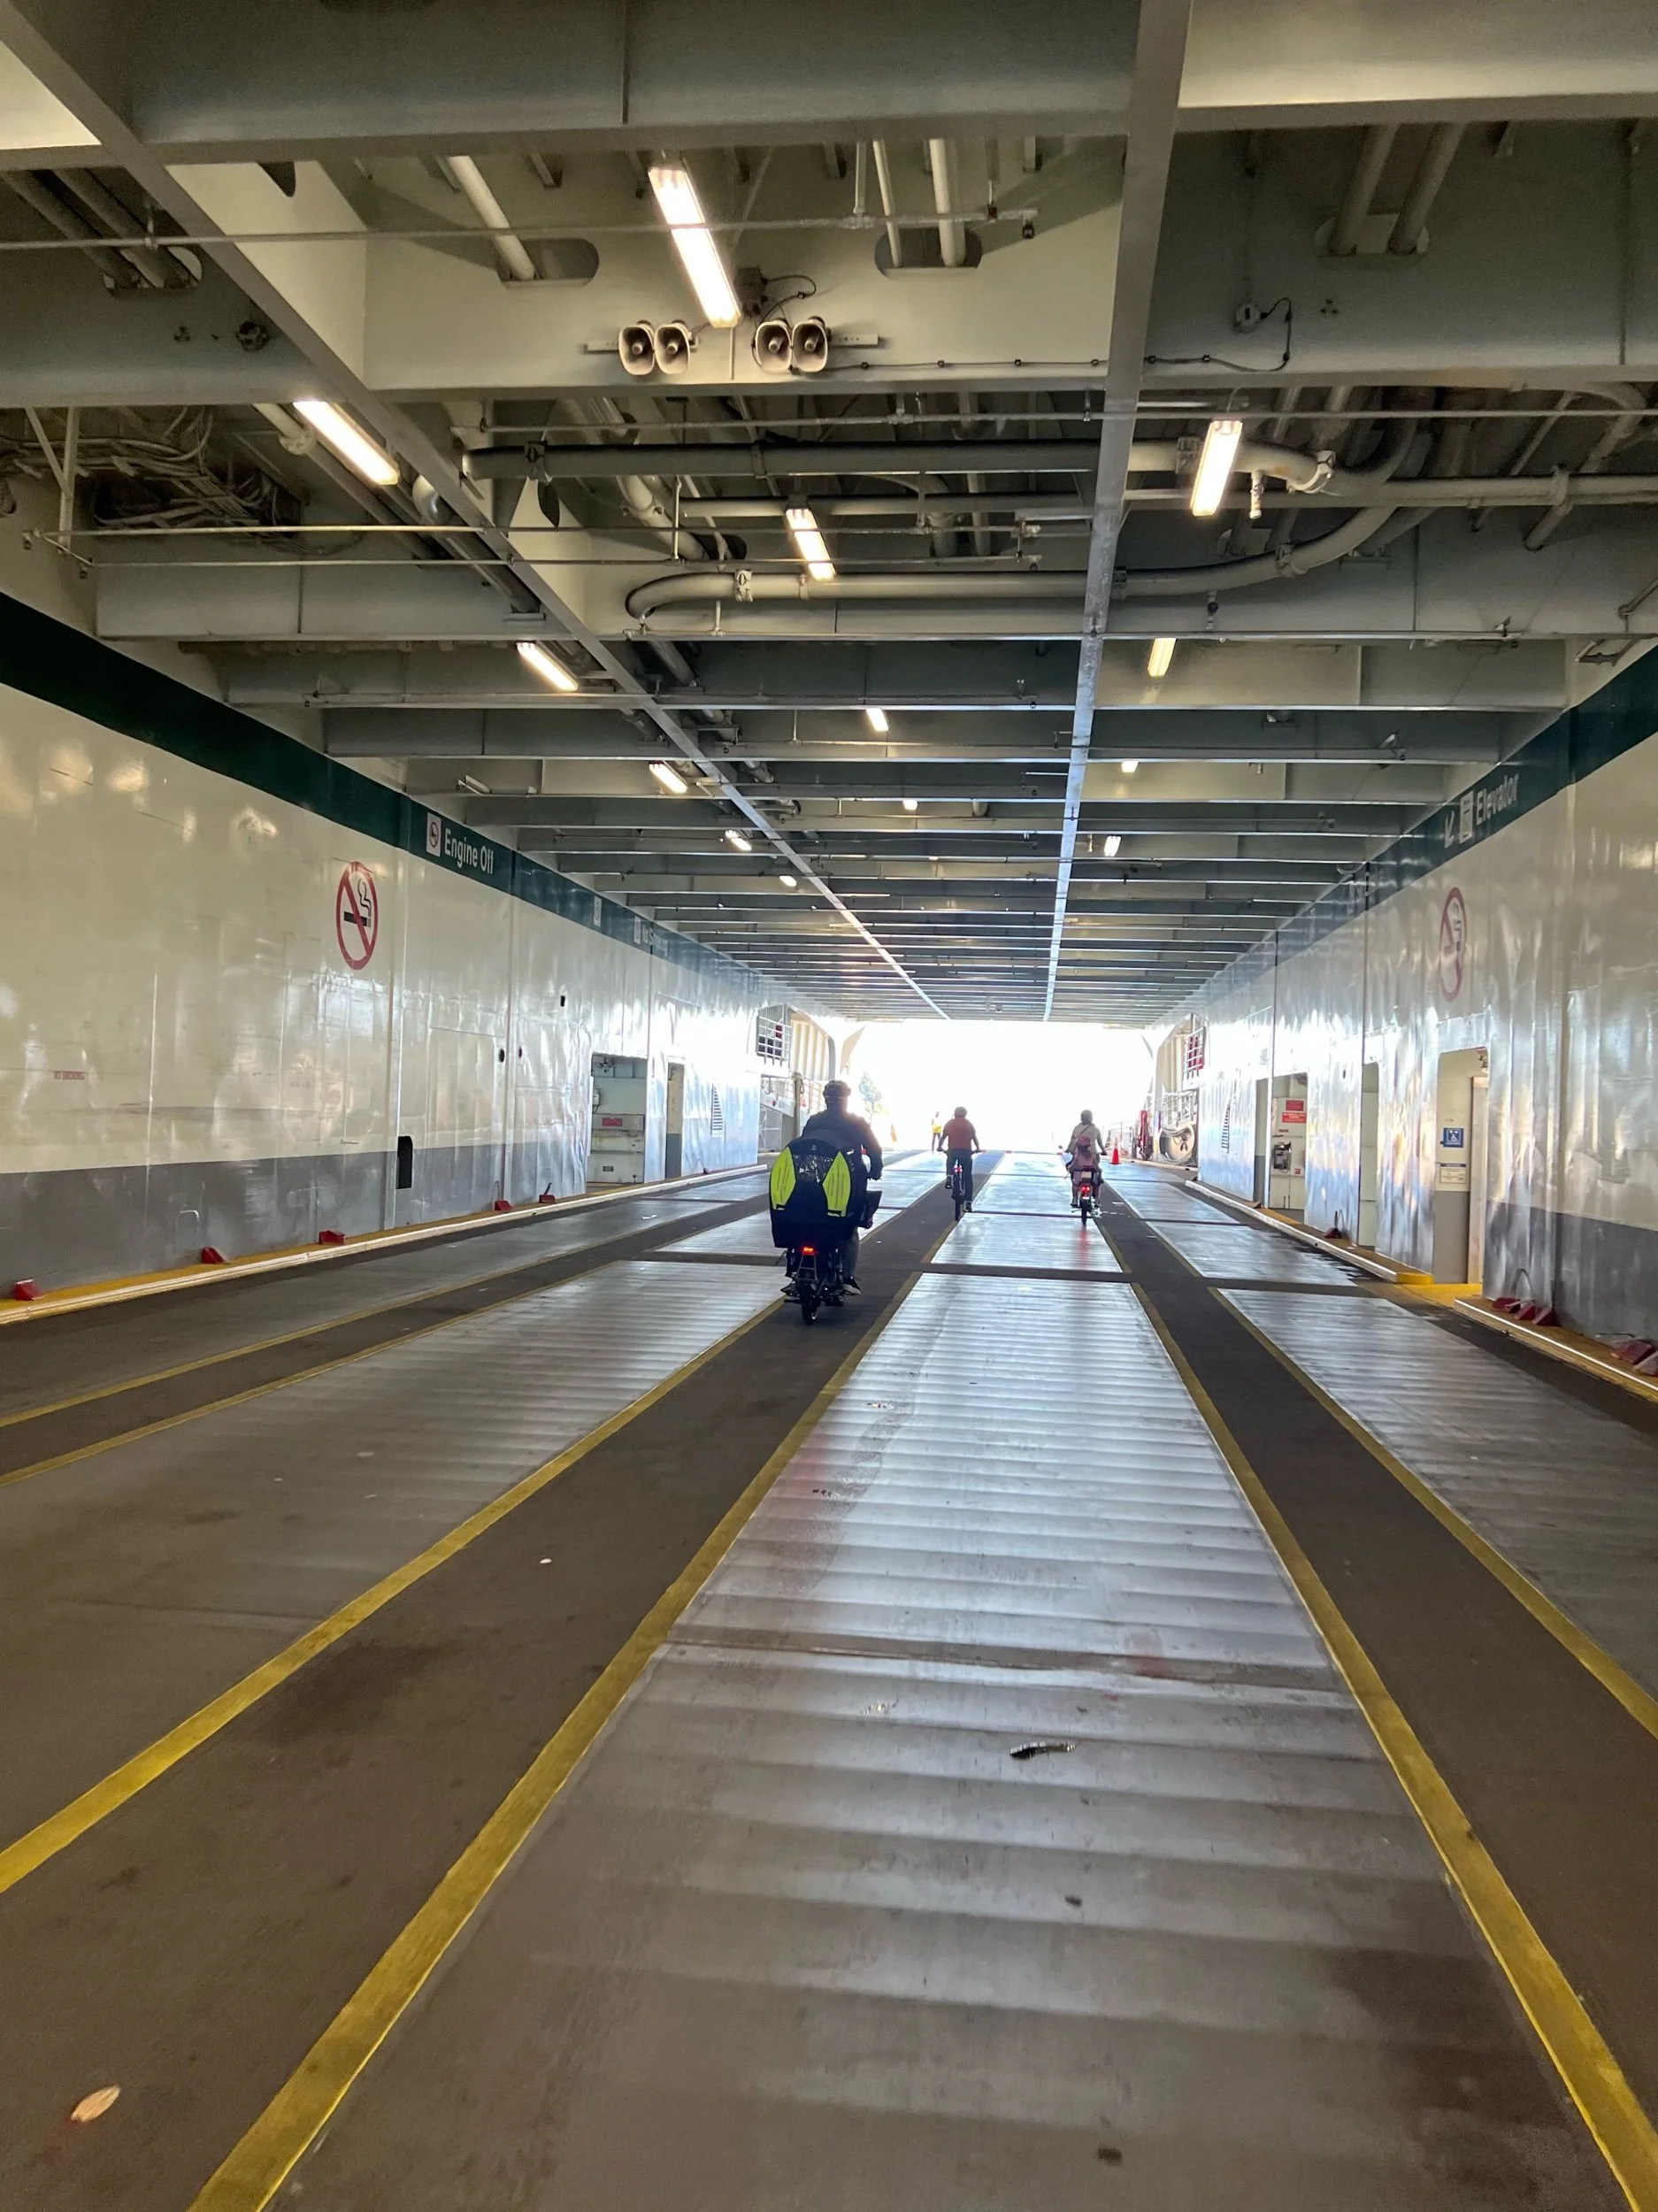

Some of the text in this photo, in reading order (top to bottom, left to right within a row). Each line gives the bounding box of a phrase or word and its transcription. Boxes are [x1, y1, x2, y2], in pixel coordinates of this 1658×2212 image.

[1477, 773, 1519, 826] Elevator
[444, 827, 494, 874] Engine Off
